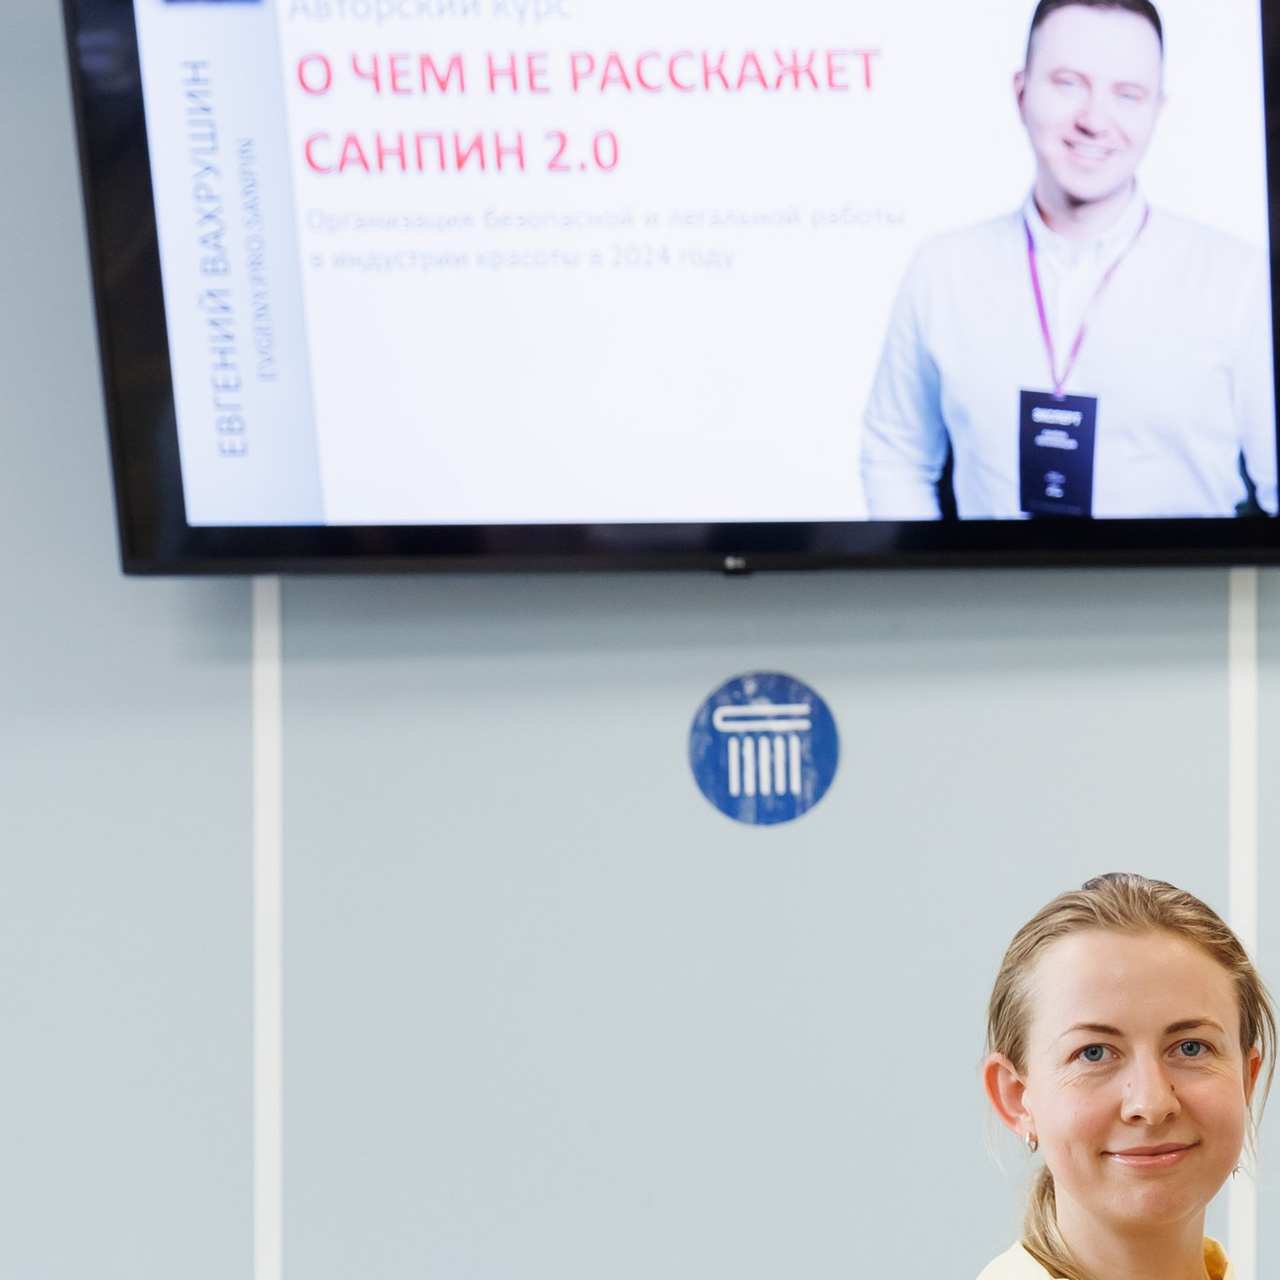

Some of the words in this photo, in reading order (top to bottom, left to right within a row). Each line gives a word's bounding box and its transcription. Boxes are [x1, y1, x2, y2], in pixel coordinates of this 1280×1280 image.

[297, 53, 333, 96] О
[351, 51, 467, 95] ЧЕМ
[486, 51, 552, 94] НЕ
[569, 48, 882, 94] РАССКАЖЕТ
[180, 60, 231, 277] ВАХРУШИН
[304, 131, 527, 175] САНПИН
[546, 129, 622, 173] 2.0
[482, 202, 638, 231] безопасной
[809, 201, 909, 234] работы
[610, 240, 672, 268] 2024
[678, 242, 738, 273] году
[199, 287, 250, 459] ЕВГЕНИЙ
